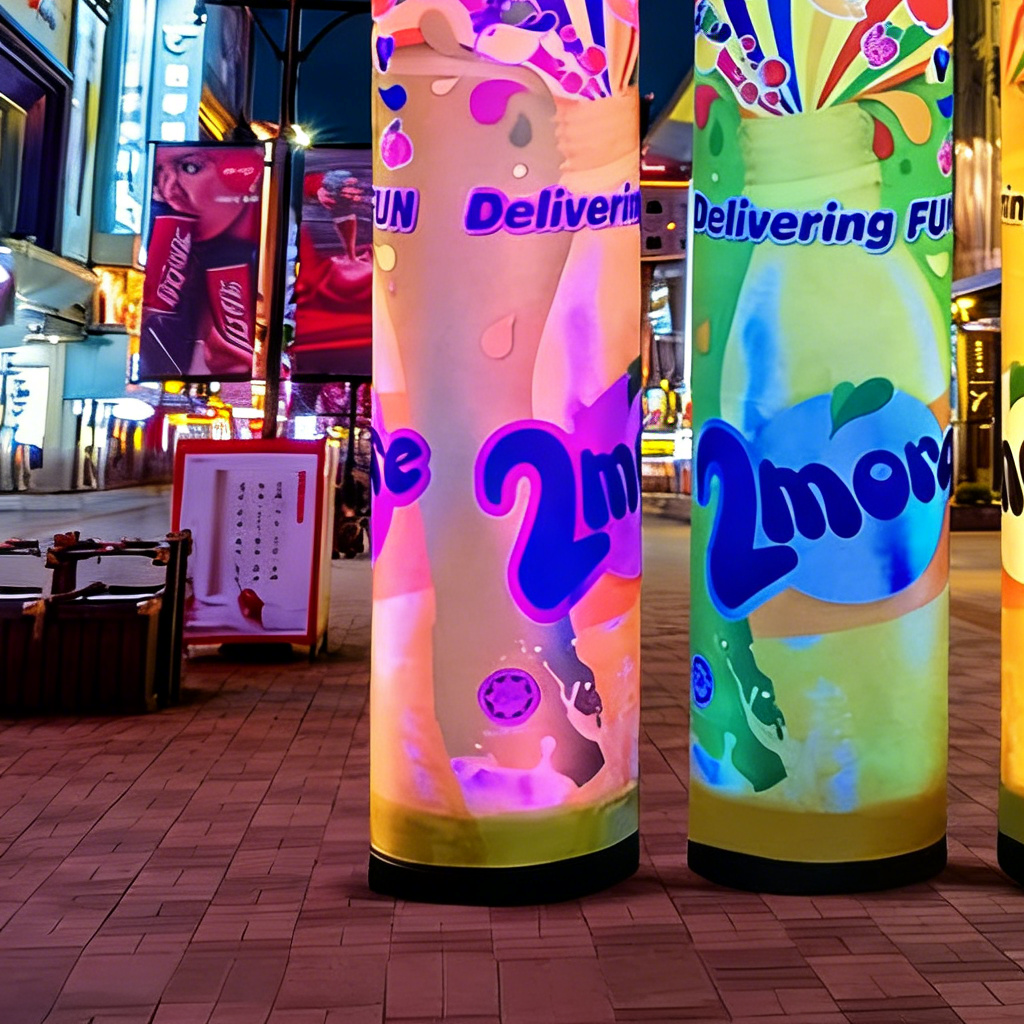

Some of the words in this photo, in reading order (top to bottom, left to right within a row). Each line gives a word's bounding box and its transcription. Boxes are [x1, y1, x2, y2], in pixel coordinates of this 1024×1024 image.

[375, 189, 415, 229] UN
[465, 182, 641, 232] Deliverin
[694, 192, 894, 250] Delivering
